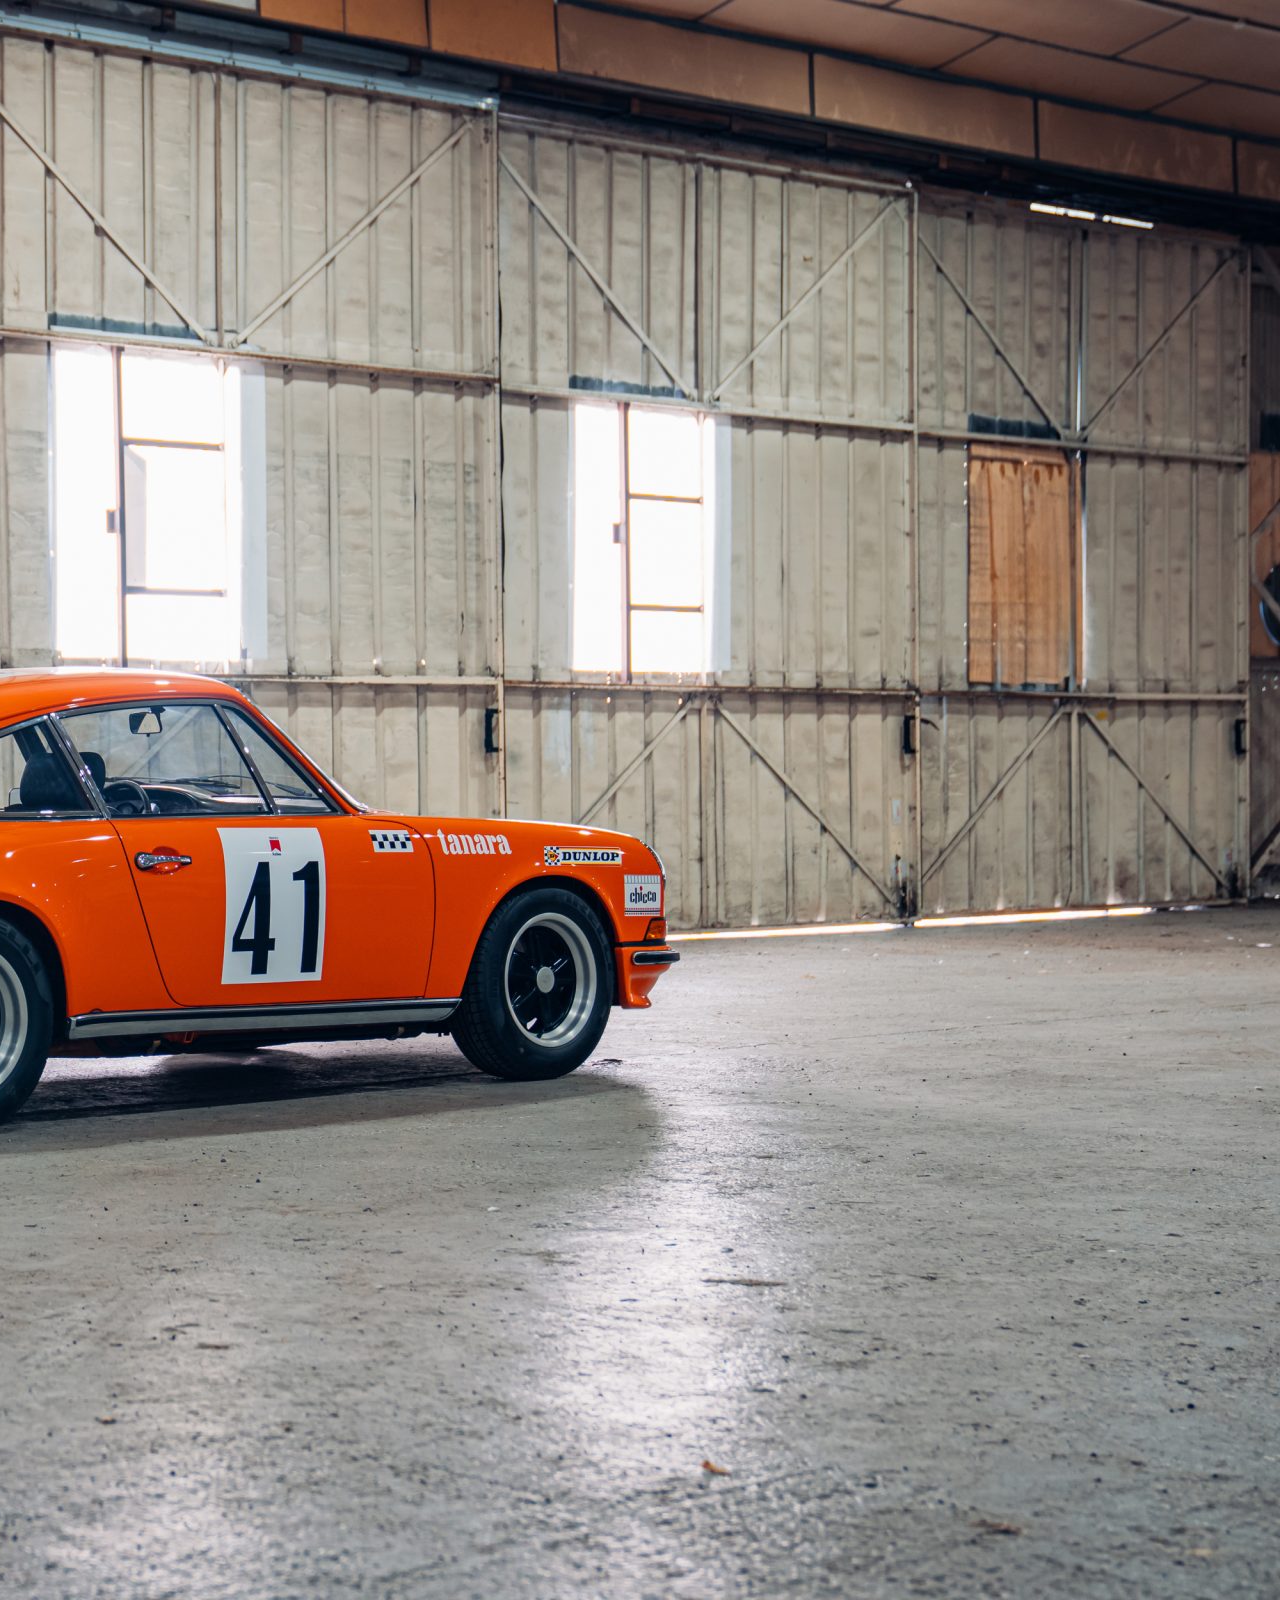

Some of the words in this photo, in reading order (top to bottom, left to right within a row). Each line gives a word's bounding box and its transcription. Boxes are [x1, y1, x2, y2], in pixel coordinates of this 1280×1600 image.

[437, 828, 513, 856] tanara
[561, 851, 620, 862] DUNLOP
[629, 885, 657, 904] chicco
[232, 861, 320, 975] 41
